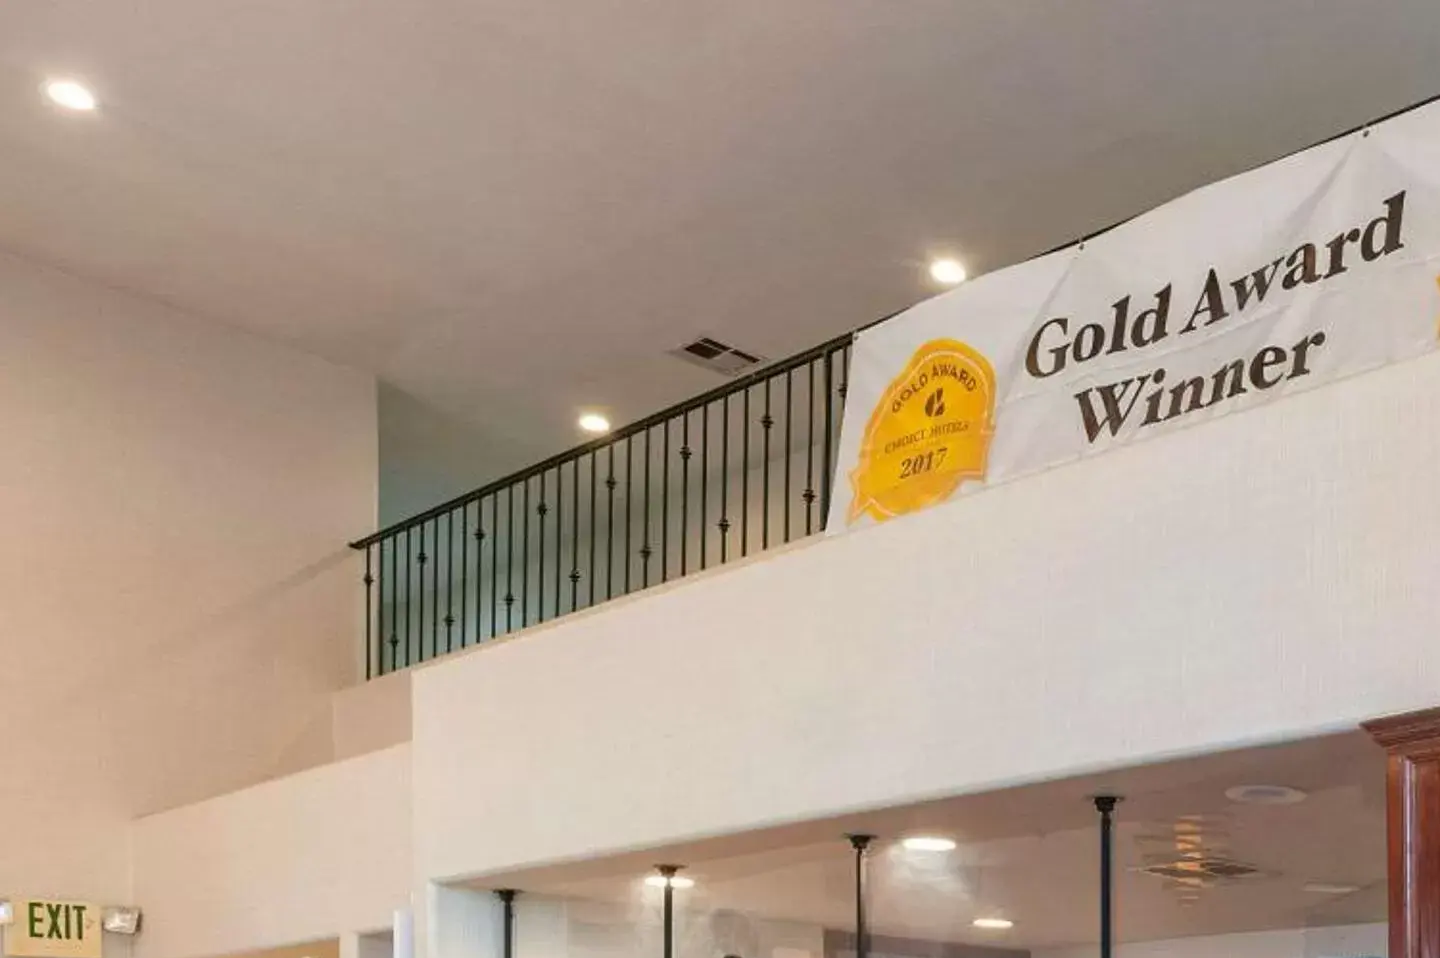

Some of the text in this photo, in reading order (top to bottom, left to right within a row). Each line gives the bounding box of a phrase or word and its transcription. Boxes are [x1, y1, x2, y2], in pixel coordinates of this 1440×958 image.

[1025, 189, 1407, 379] Gold Award
[891, 363, 978, 413] GOLD AWARD
[1074, 330, 1326, 444] Winner
[899, 447, 948, 479] 2017
[28, 902, 87, 940] EXIT
